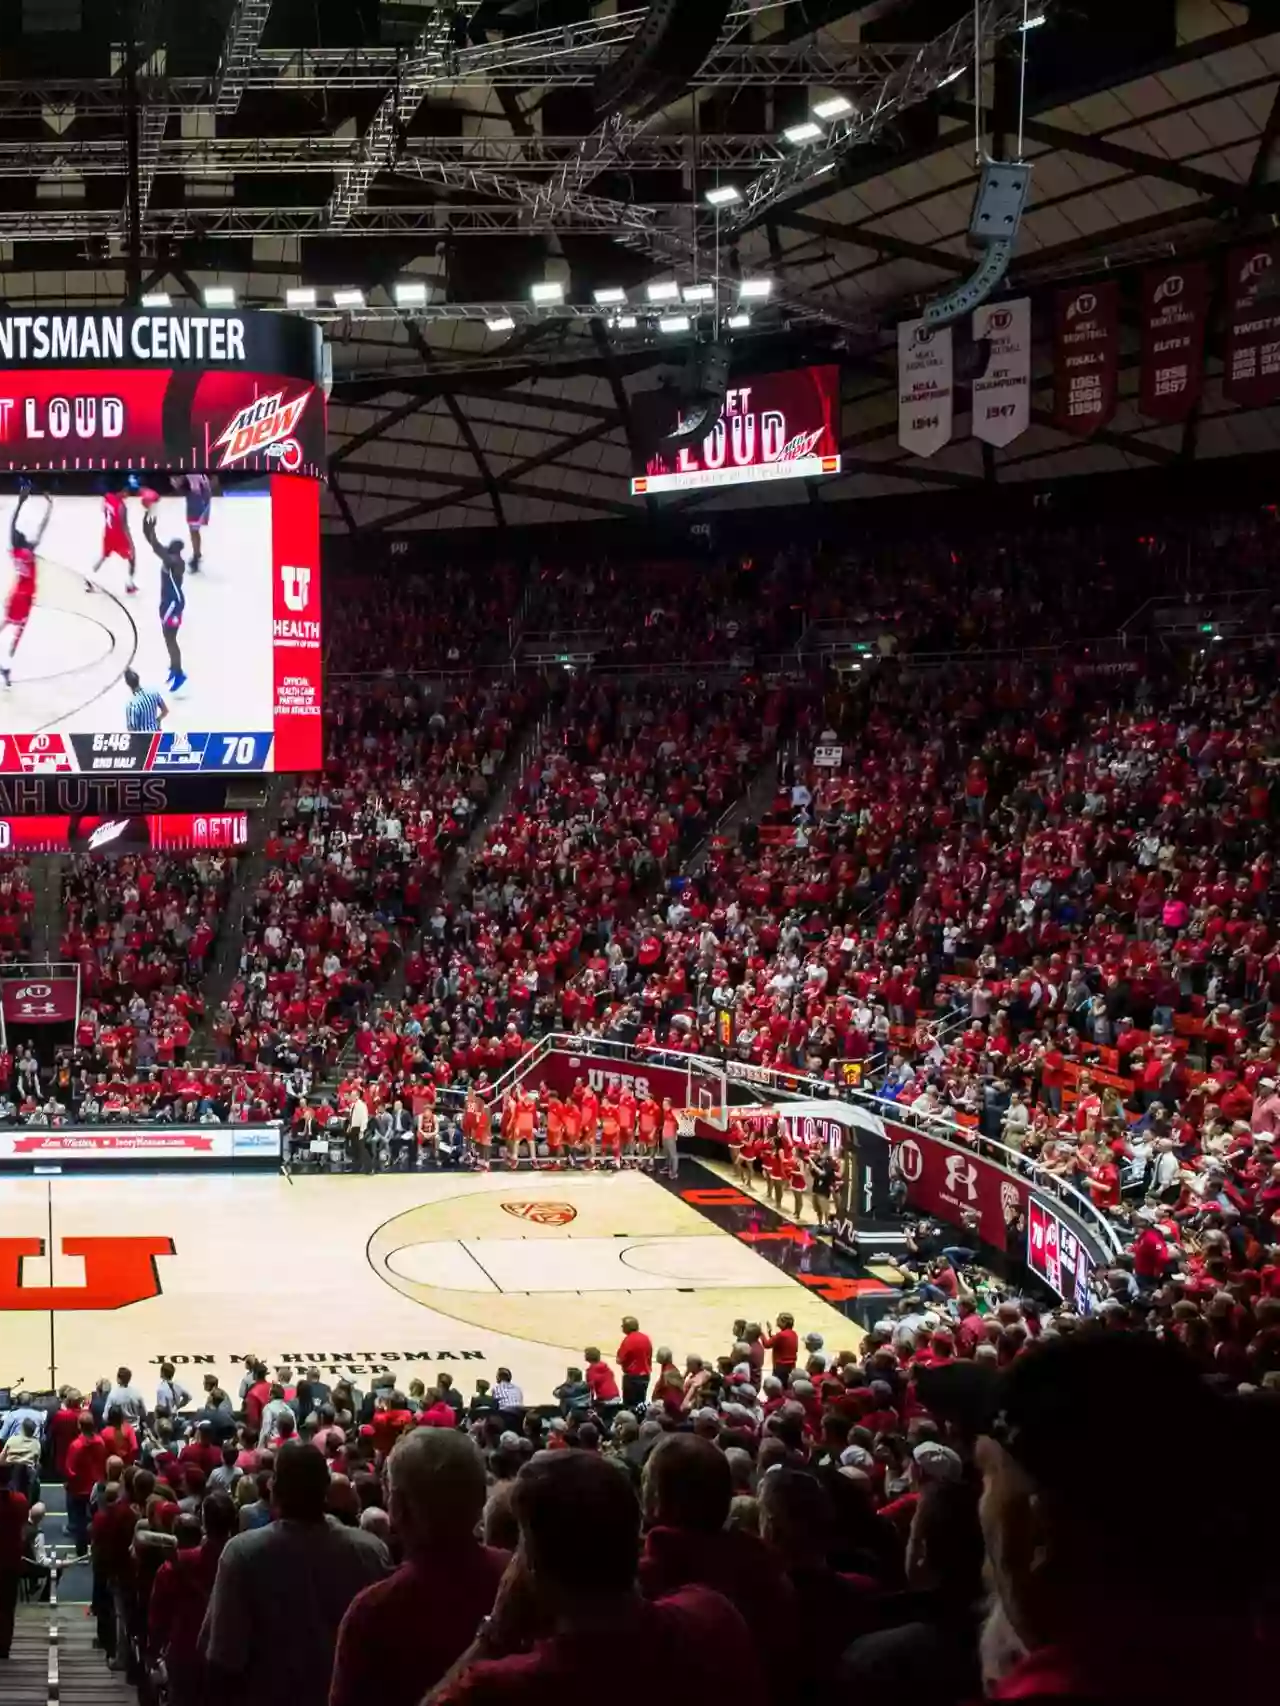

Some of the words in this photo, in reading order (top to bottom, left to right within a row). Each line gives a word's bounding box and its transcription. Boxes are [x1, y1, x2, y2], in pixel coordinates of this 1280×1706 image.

[130, 316, 246, 361] CENTER
[1098, 351, 1105, 362] 4
[719, 387, 752, 417] ET
[986, 404, 1016, 420] 1947
[27, 396, 125, 440] LOUD
[911, 416, 939, 430] 1944
[678, 411, 786, 472] LOUD
[281, 566, 311, 611] U
[273, 620, 320, 639] HEALTH
[222, 737, 256, 764] 70
[56, 778, 168, 813] UTES
[193, 818, 233, 846] GET
[588, 1068, 651, 1100] UTES
[148, 1354, 216, 1364] JON
[280, 1350, 487, 1363] HUNTSMAN
[271, 1364, 391, 1377] ENTER
